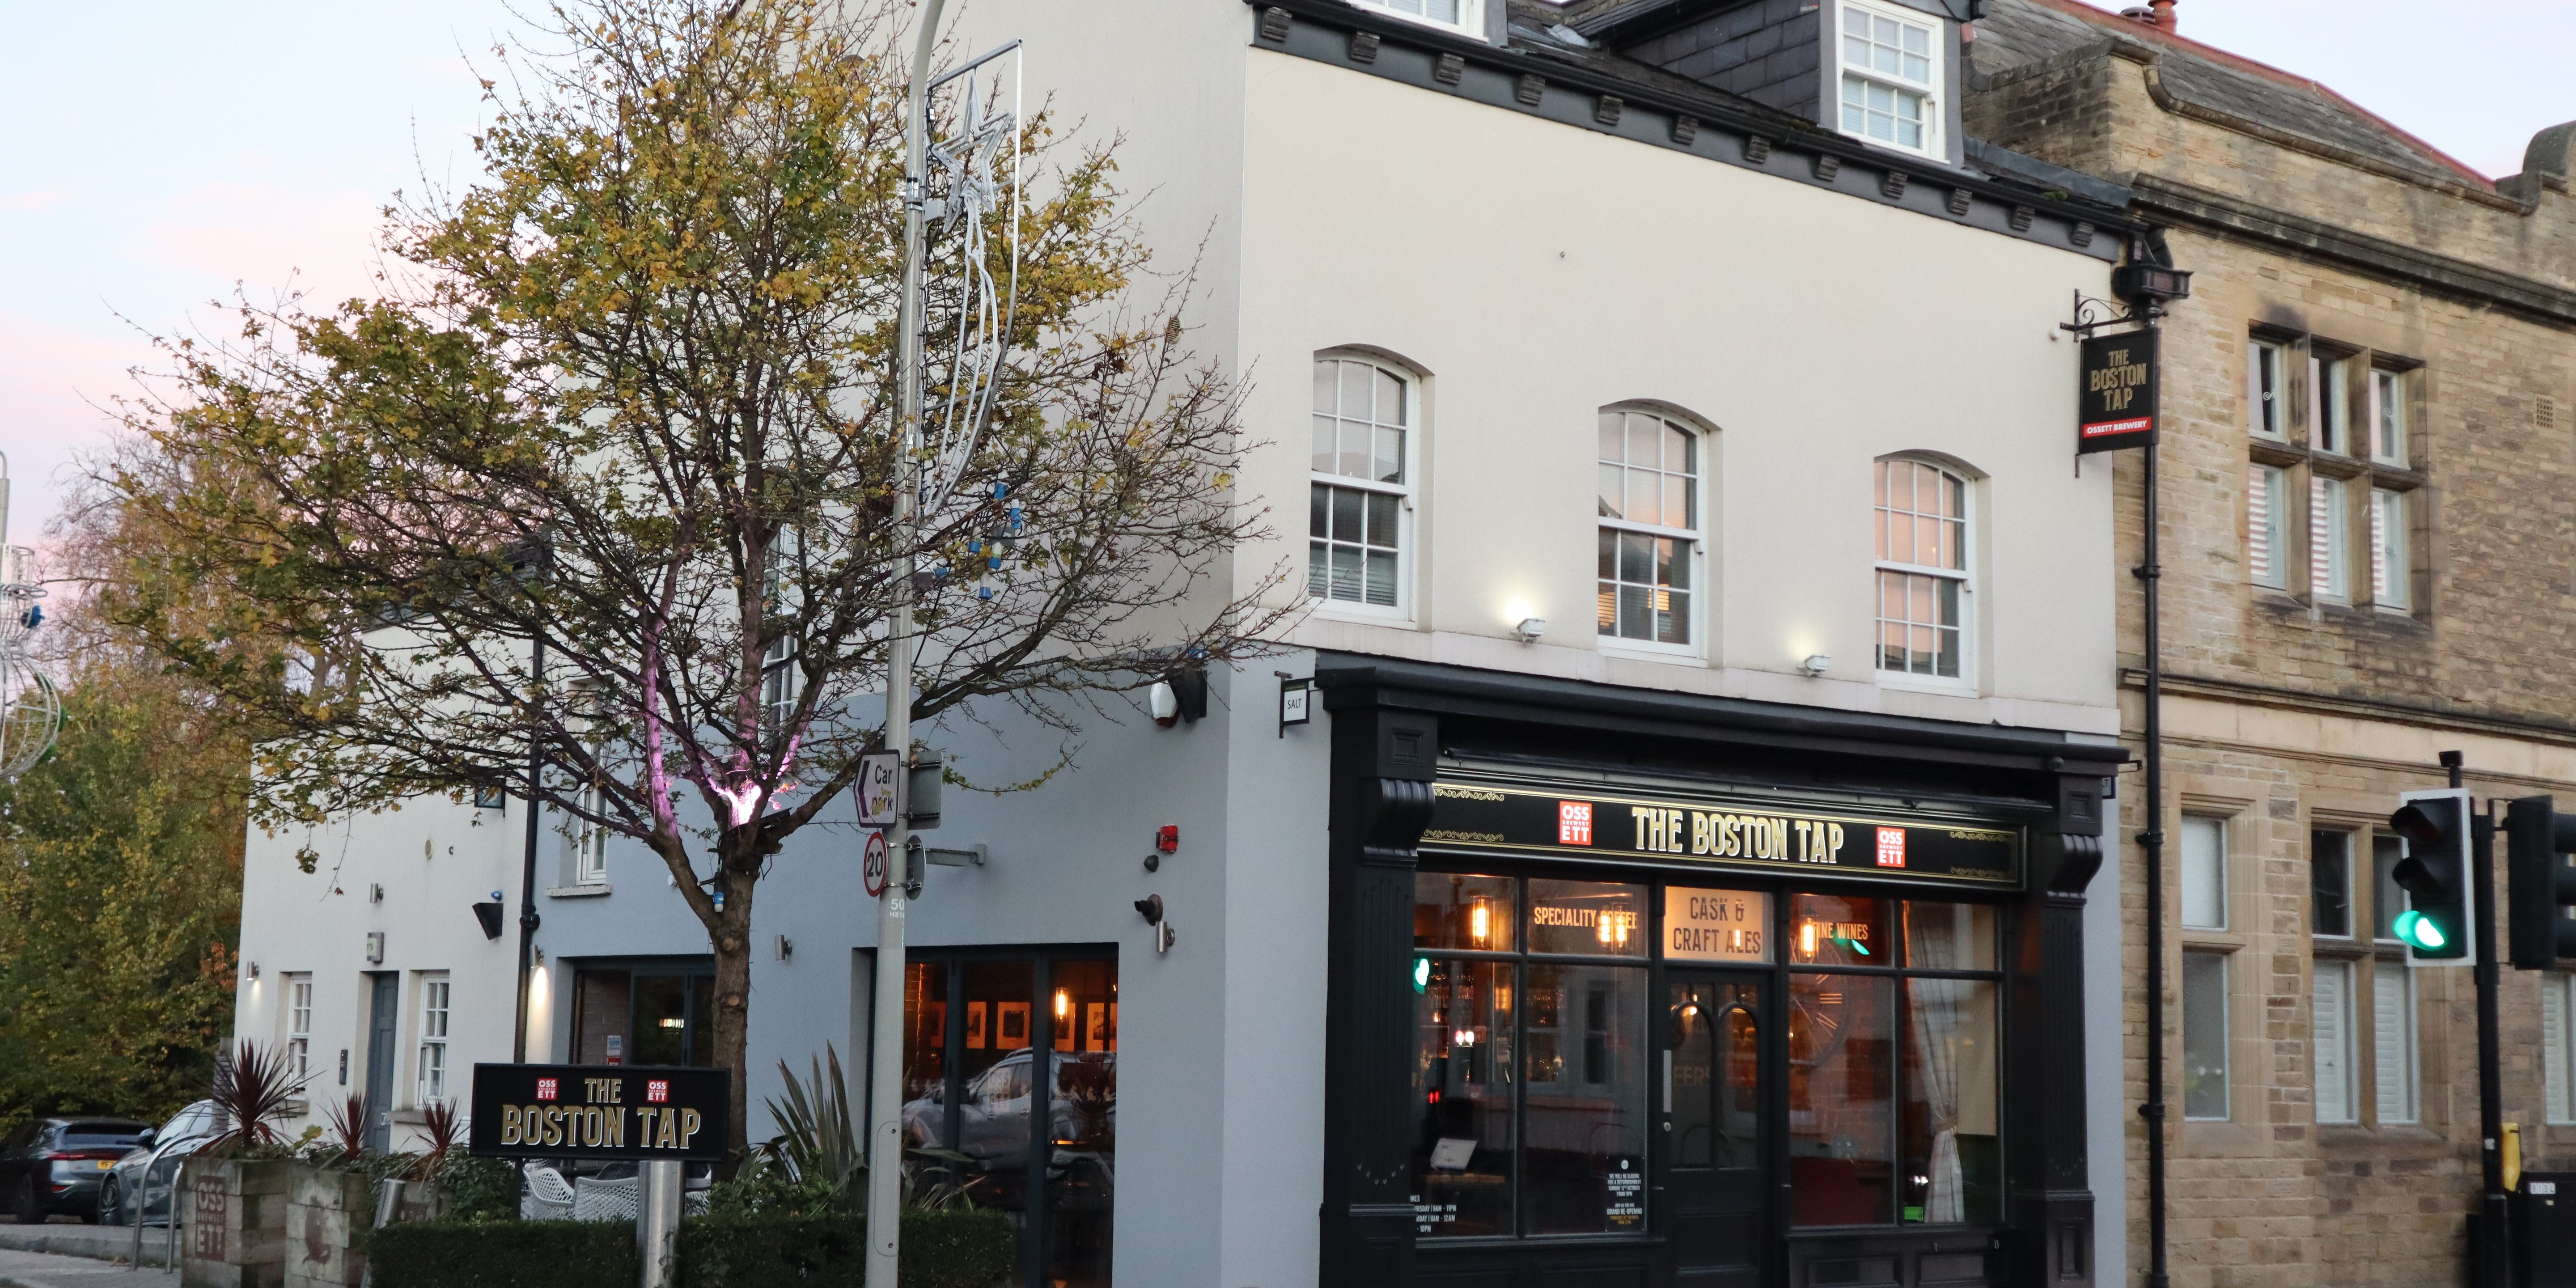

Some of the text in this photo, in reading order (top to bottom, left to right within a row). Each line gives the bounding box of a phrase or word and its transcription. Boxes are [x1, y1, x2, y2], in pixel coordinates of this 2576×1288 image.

[2109, 349, 2129, 366] THE
[2091, 363, 2147, 391] BOSTON
[2104, 387, 2133, 411] TAP
[2087, 420, 2147, 434] OSSETT BREWERY
[1288, 698, 1302, 709] SALT
[875, 764, 892, 784] Car
[1562, 805, 1590, 821] OSS
[1562, 826, 1589, 842] ETT
[1631, 806, 1844, 864] THE BOSTON TAP
[1879, 830, 1903, 845] OSS
[867, 851, 883, 877] 20
[1879, 849, 1903, 864] ETT
[890, 898, 905, 911] 50
[1690, 896, 1728, 921] CASK
[1534, 907, 1597, 927] SPECIALITY
[1674, 927, 1720, 953] CRAFT
[1836, 922, 1868, 941] WINES
[538, 1080, 556, 1088] OSS
[585, 1078, 622, 1104] THE
[649, 1082, 666, 1090] OSS
[538, 1090, 555, 1099] ETT
[648, 1092, 666, 1101] ETT
[500, 1104, 700, 1149] BOSTON TAP
